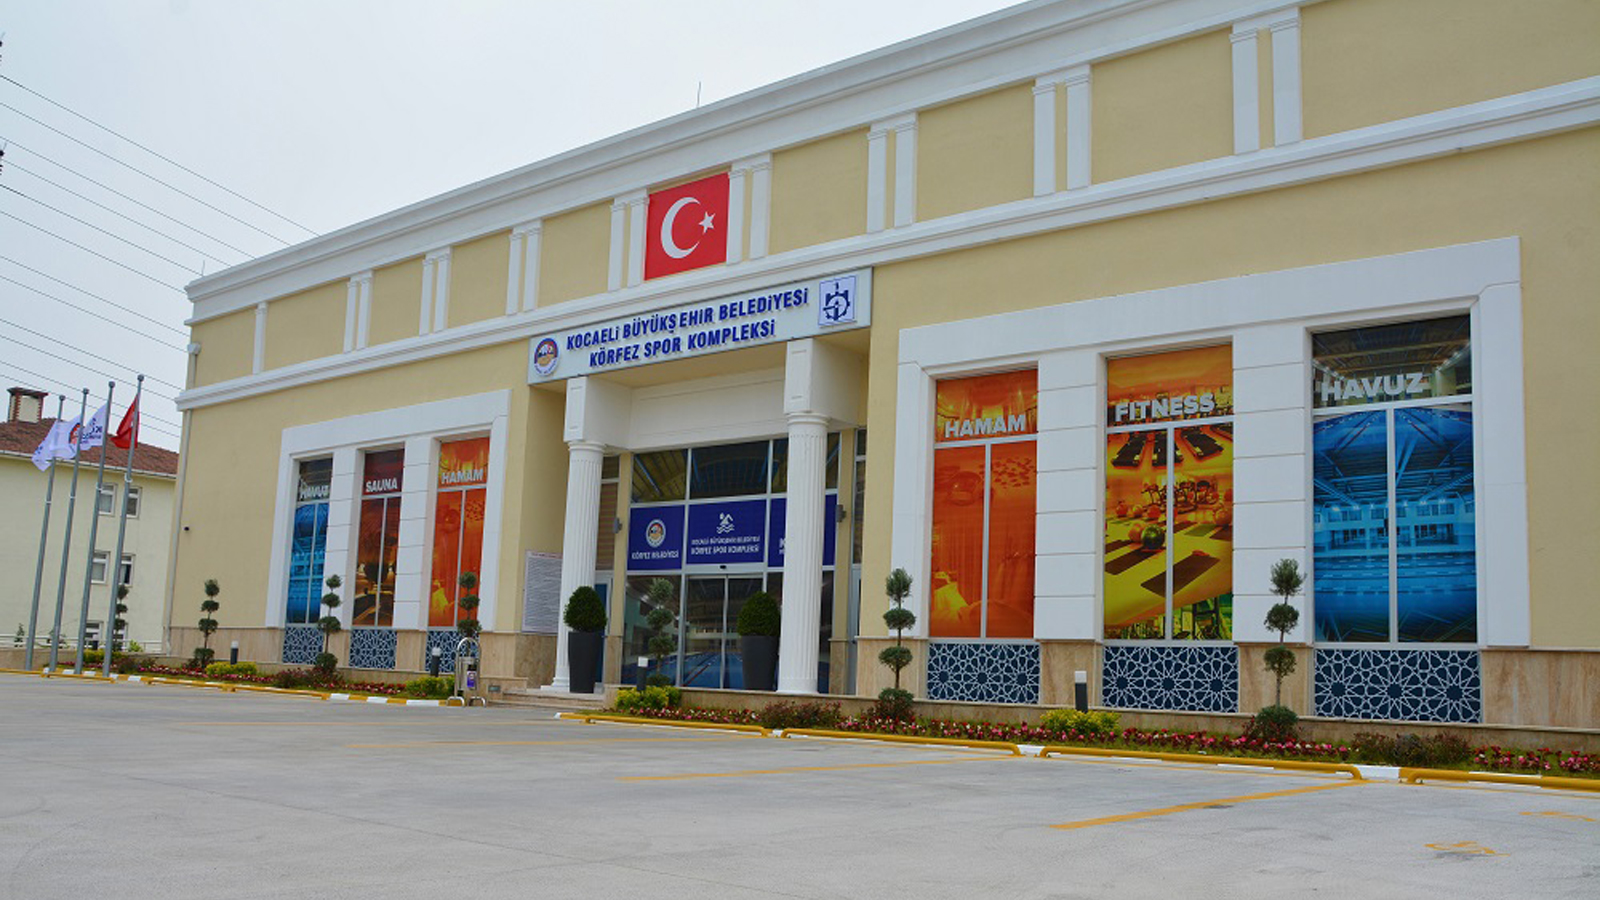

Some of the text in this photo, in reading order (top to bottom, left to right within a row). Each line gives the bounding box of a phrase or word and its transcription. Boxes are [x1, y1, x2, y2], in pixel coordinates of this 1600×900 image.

[590, 345, 640, 367] KÖRFEZ
[644, 337, 681, 358] SPOR
[1321, 372, 1425, 401] HAVUZ
[1115, 392, 1215, 422] FITNESS
[944, 414, 1026, 438] HAMAM
[366, 478, 398, 492] SAUNA
[441, 469, 484, 484] HAMAM
